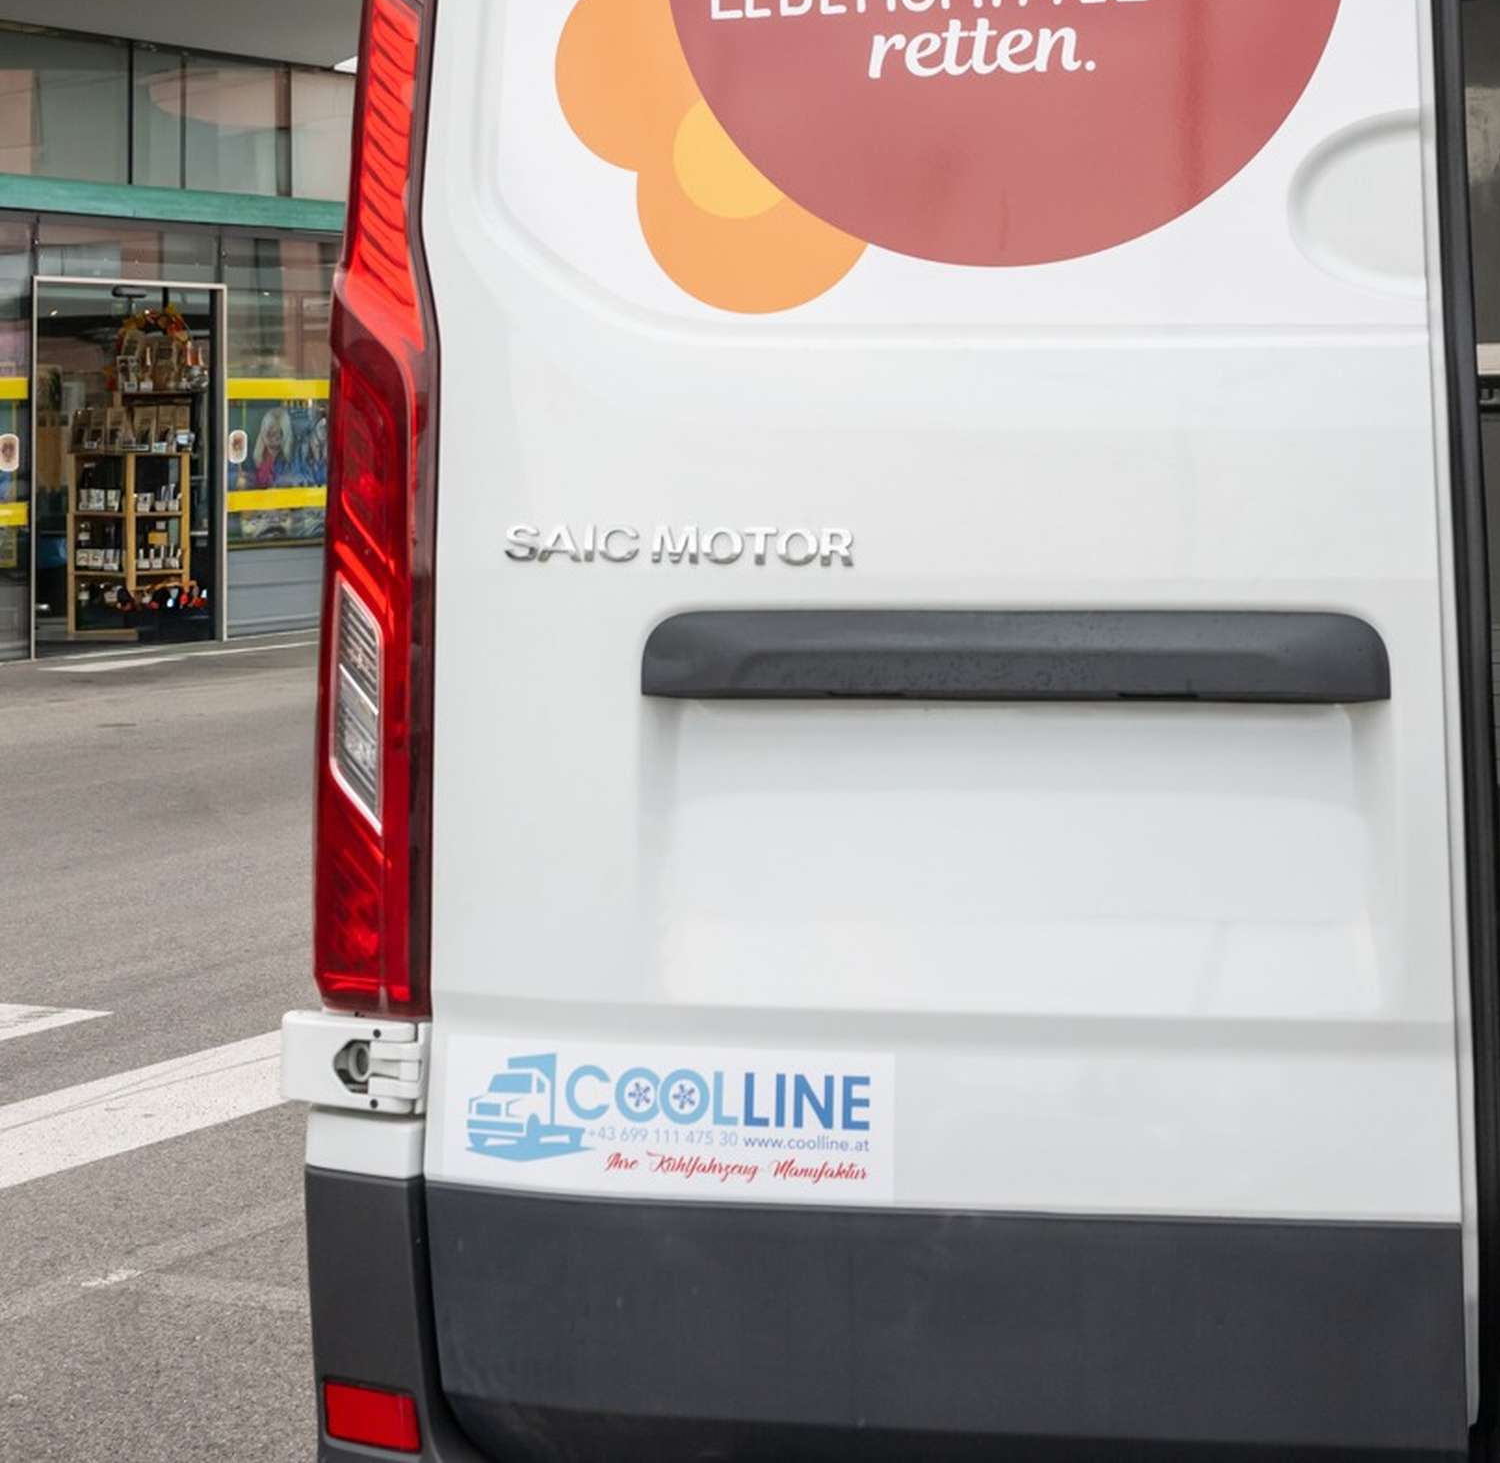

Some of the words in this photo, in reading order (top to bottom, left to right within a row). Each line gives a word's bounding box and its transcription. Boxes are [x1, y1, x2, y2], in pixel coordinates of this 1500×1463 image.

[868, 17, 1097, 79] retten.
[504, 523, 641, 563] SAIC
[651, 524, 855, 567] MOTOR
[565, 1065, 871, 1131] COOLLINE
[605, 1152, 639, 1171] Ihre
[620, 1127, 649, 1143] 699
[653, 1129, 680, 1144] 111
[686, 1130, 714, 1145] 475
[719, 1131, 738, 1146] 30
[744, 1134, 870, 1152] www.coolline.at
